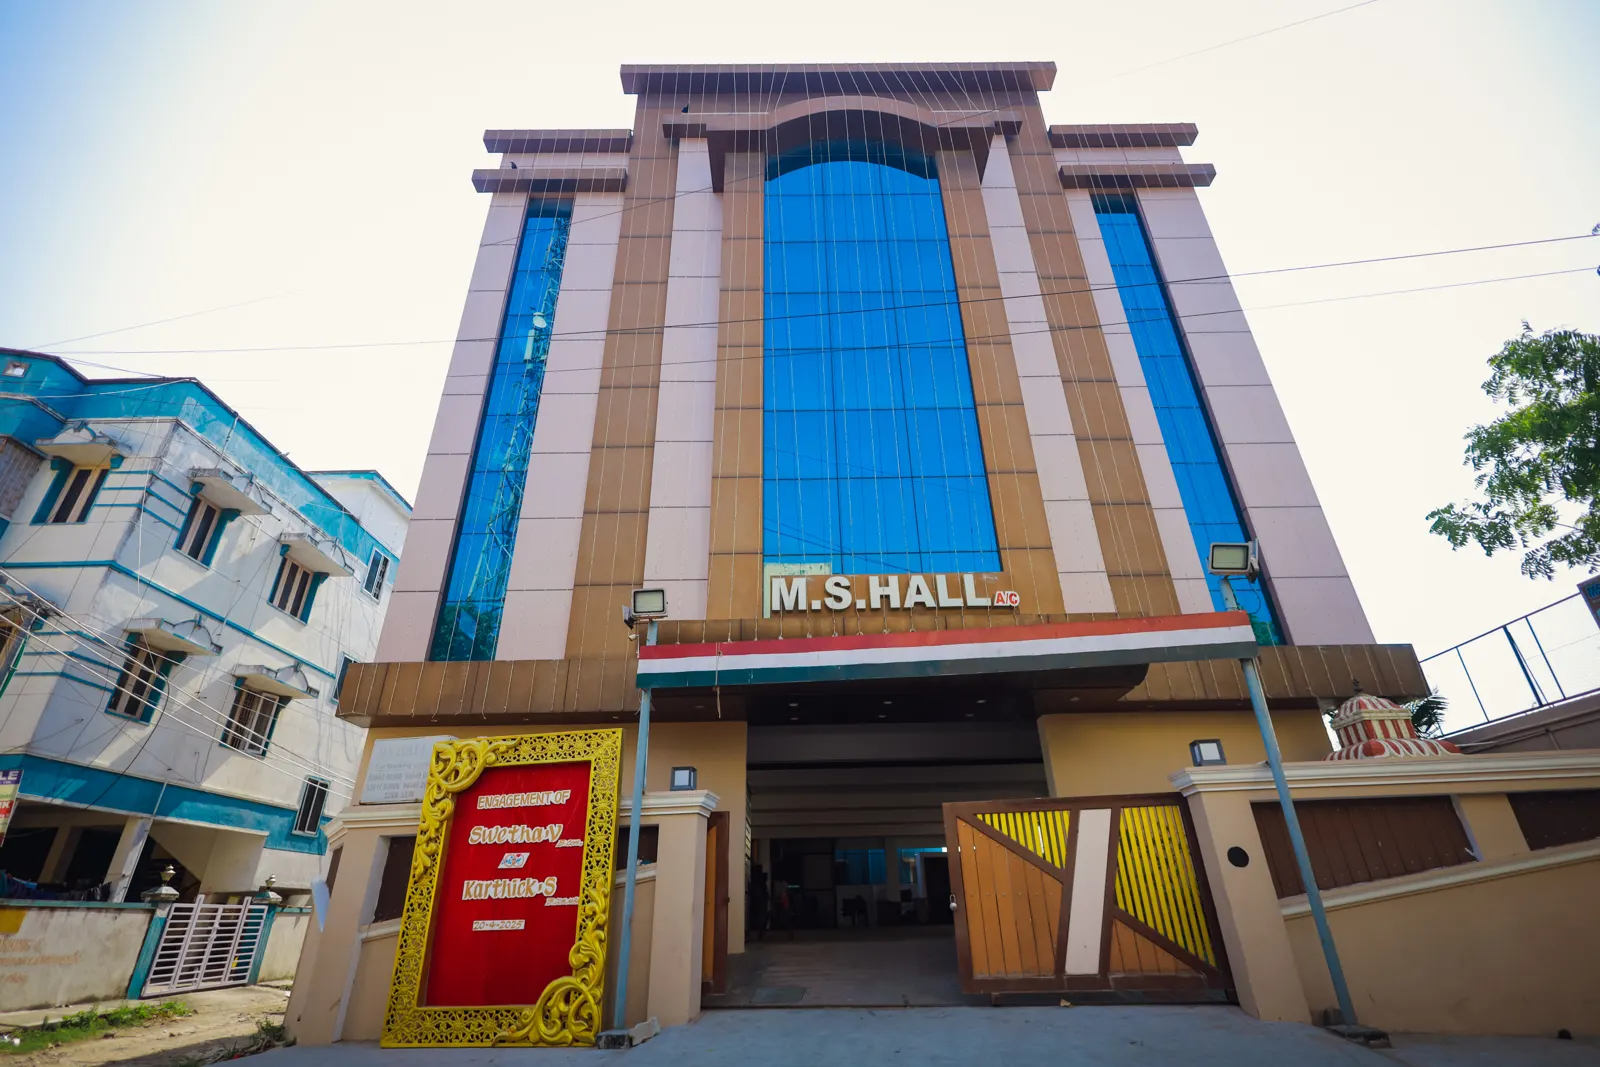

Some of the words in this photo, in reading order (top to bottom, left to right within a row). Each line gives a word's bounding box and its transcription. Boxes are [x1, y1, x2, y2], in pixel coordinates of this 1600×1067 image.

[770, 574, 992, 611] M.S.HALL
[994, 590, 1020, 607] A/C
[477, 792, 553, 809] ENGAGEMENT
[554, 790, 571, 804] OF
